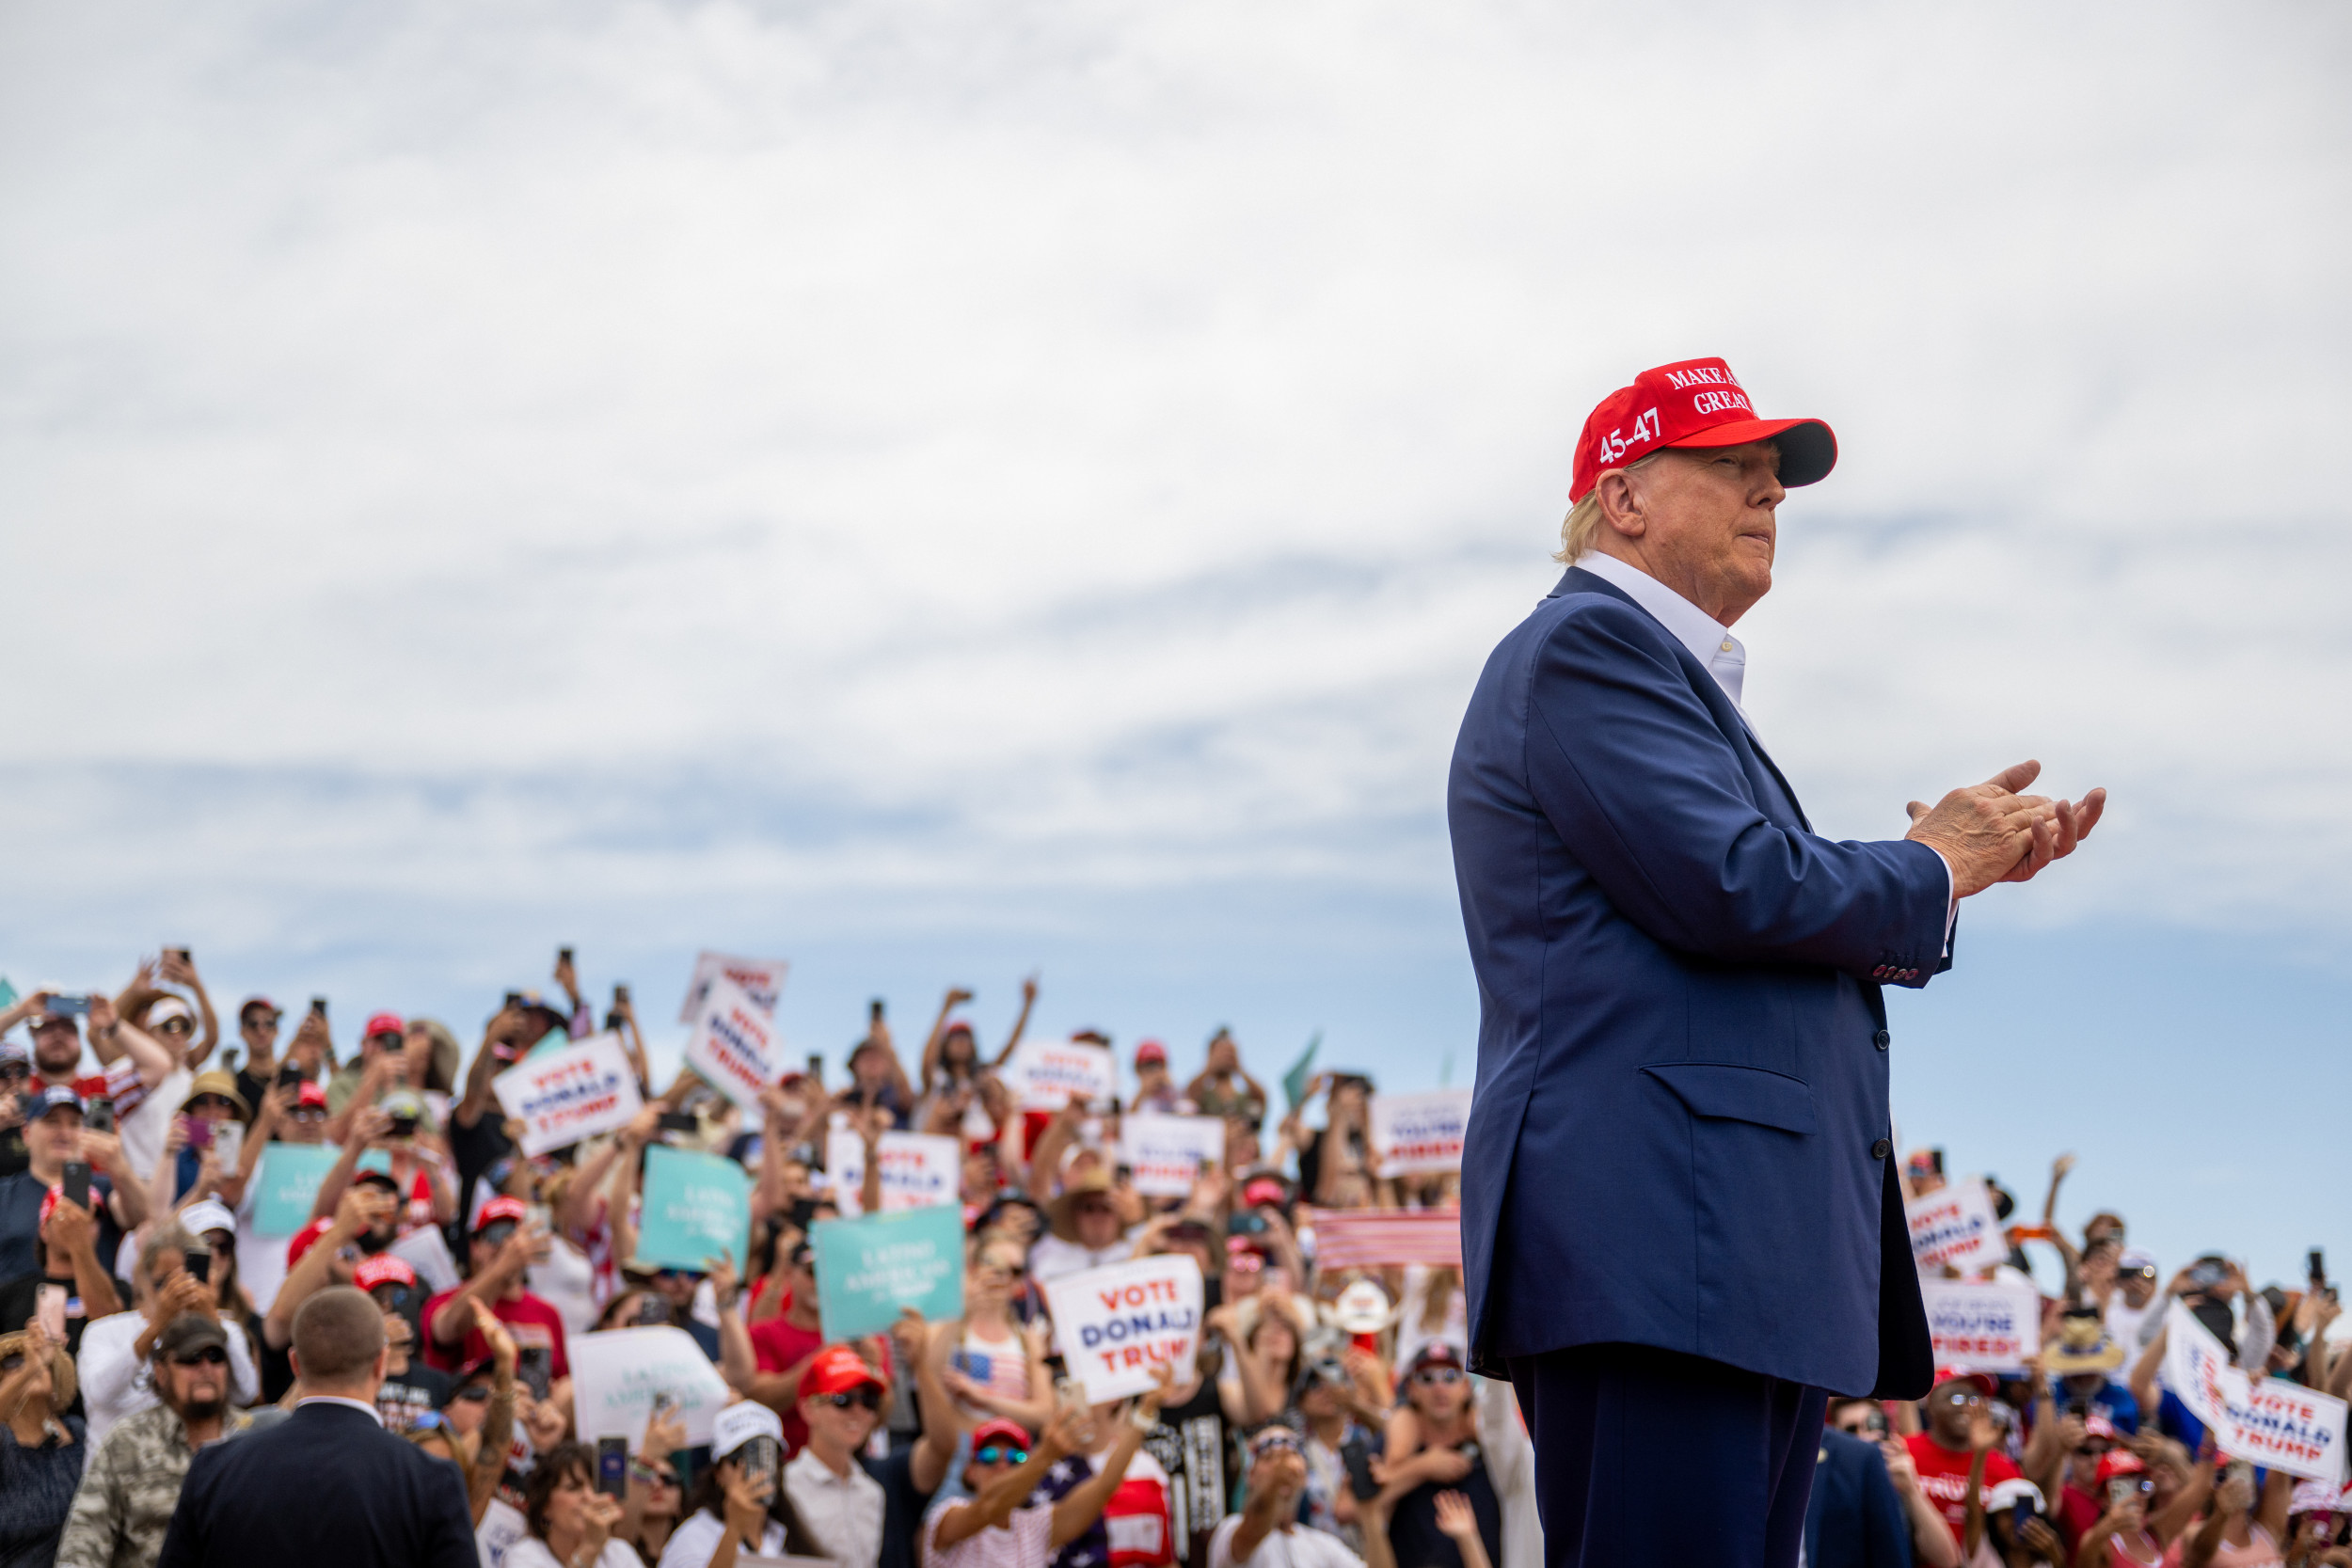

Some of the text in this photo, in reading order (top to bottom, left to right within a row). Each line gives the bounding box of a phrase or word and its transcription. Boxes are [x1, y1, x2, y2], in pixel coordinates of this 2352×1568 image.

[1664, 367, 1727, 390] MAKE
[1599, 406, 1661, 464] 45-47
[1098, 1276, 1179, 1313] VOTE
[1080, 1307, 1193, 1349] DONALD
[2247, 1388, 2317, 1422] VOTE
[2233, 1423, 2323, 1464] TRUMP
